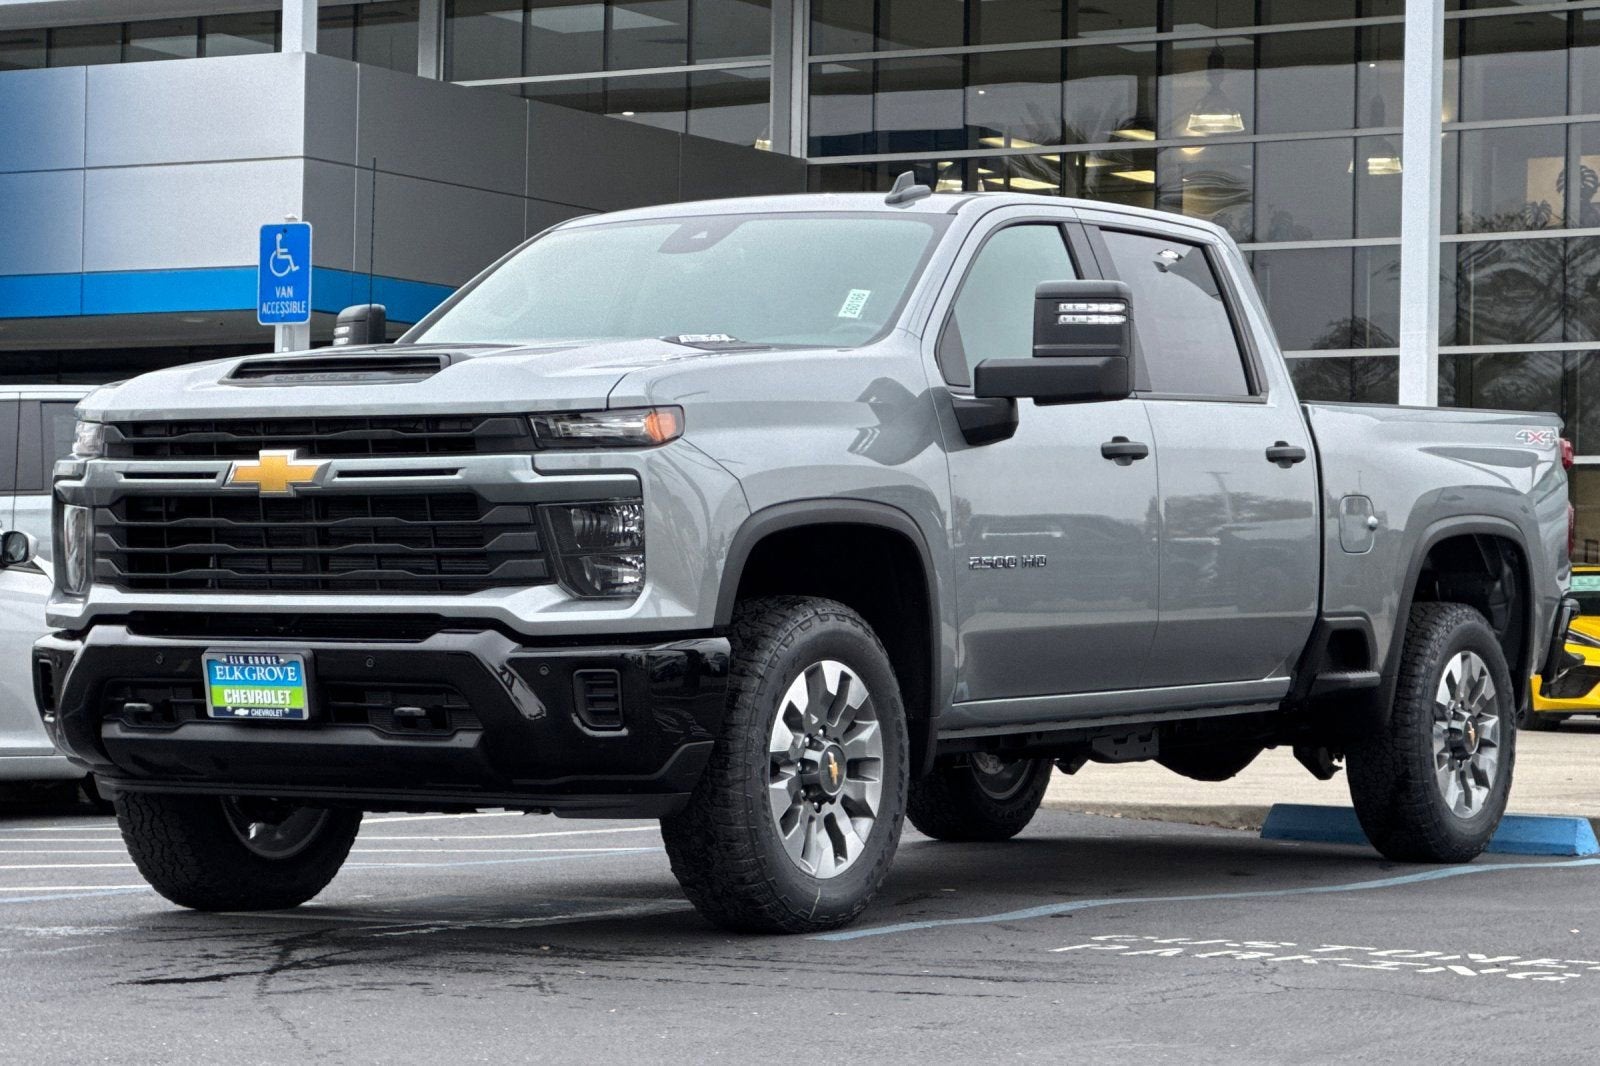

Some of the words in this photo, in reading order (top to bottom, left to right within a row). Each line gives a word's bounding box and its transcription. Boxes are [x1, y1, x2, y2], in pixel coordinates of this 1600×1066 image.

[275, 286, 294, 298] VAN
[262, 300, 307, 314] ACCESSIBLE
[969, 555, 1017, 570] 2500
[1021, 554, 1047, 569] HD
[230, 656, 245, 665] ELK
[248, 656, 277, 665] GROVE
[223, 688, 291, 705] CHEVROLET
[250, 708, 284, 717] CHEVROLET
[1049, 944, 1581, 982] PARKING
